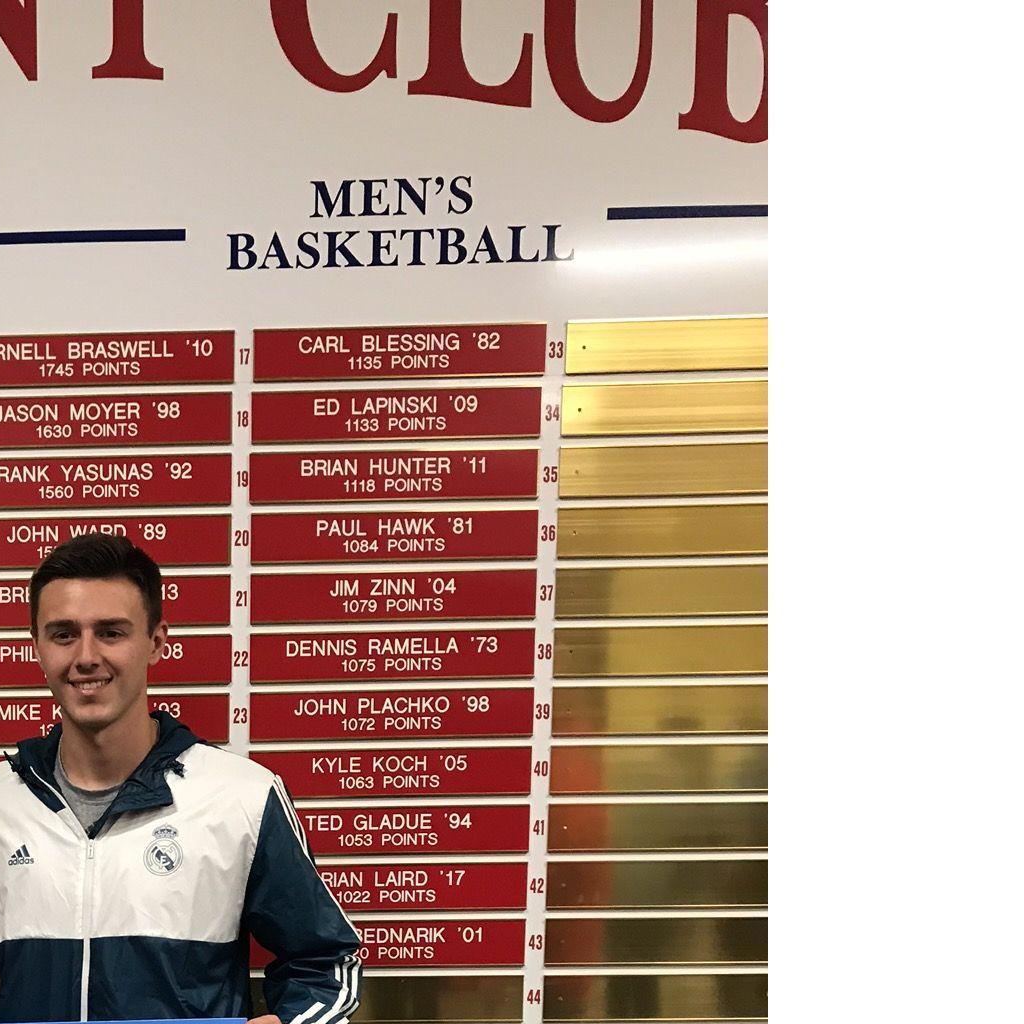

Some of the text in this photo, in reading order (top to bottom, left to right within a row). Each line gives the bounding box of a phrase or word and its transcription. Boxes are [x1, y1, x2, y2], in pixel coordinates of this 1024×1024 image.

[309, 175, 473, 219] MEN'S
[226, 224, 575, 271] BASKETBALL
[67, 339, 174, 360] BRASWELL
[186, 338, 213, 357] '10
[298, 331, 501, 354] CARL BLESSING '82
[548, 340, 564, 359] 33
[239, 347, 251, 366] 17
[347, 353, 450, 370] 1135 POINTS
[38, 361, 141, 378] 1745 POINTS
[69, 401, 141, 421] MOYER
[152, 401, 181, 419] '98
[313, 394, 479, 416] ED LAPINSKI '09
[35, 422, 139, 439] 1630 POINTS
[344, 416, 447, 432] 1133 POINTS
[60, 462, 154, 482] YASUNAS
[164, 461, 193, 480] '92
[300, 456, 486, 477] BRIAN HUNTER '11
[38, 483, 140, 500] 1560 POINTS
[343, 477, 443, 493] 1118 POINTS
[6, 525, 59, 544] JOHN
[138, 523, 167, 541] '89
[316, 517, 473, 537] PAUL HAWK '81
[342, 537, 446, 554] 1084 POINTS
[329, 577, 457, 597] JIM ZINN '04
[342, 597, 444, 613] 1079 POINTS
[286, 636, 498, 658] DENNIS RAMELLA '73
[233, 650, 249, 668] 22
[341, 656, 442, 673] 1075 POINTS
[153, 701, 181, 719] '93
[293, 695, 490, 716] JOHN PLACHKO '98
[341, 715, 442, 731] 1072 POINTS
[311, 754, 468, 774] KYLE KOCH '05
[338, 774, 440, 790] 1063 POINTS
[304, 812, 473, 832] TED GLADUE '94
[532, 819, 545, 836] 41
[337, 832, 439, 847] 1053 POINTS
[7, 856, 35, 867] adidas
[374, 870, 429, 887] LAIRD
[439, 869, 466, 886] '17
[336, 889, 436, 904] 1022 POINTS
[457, 926, 483, 943] '01
[377, 946, 434, 960] POINTS
